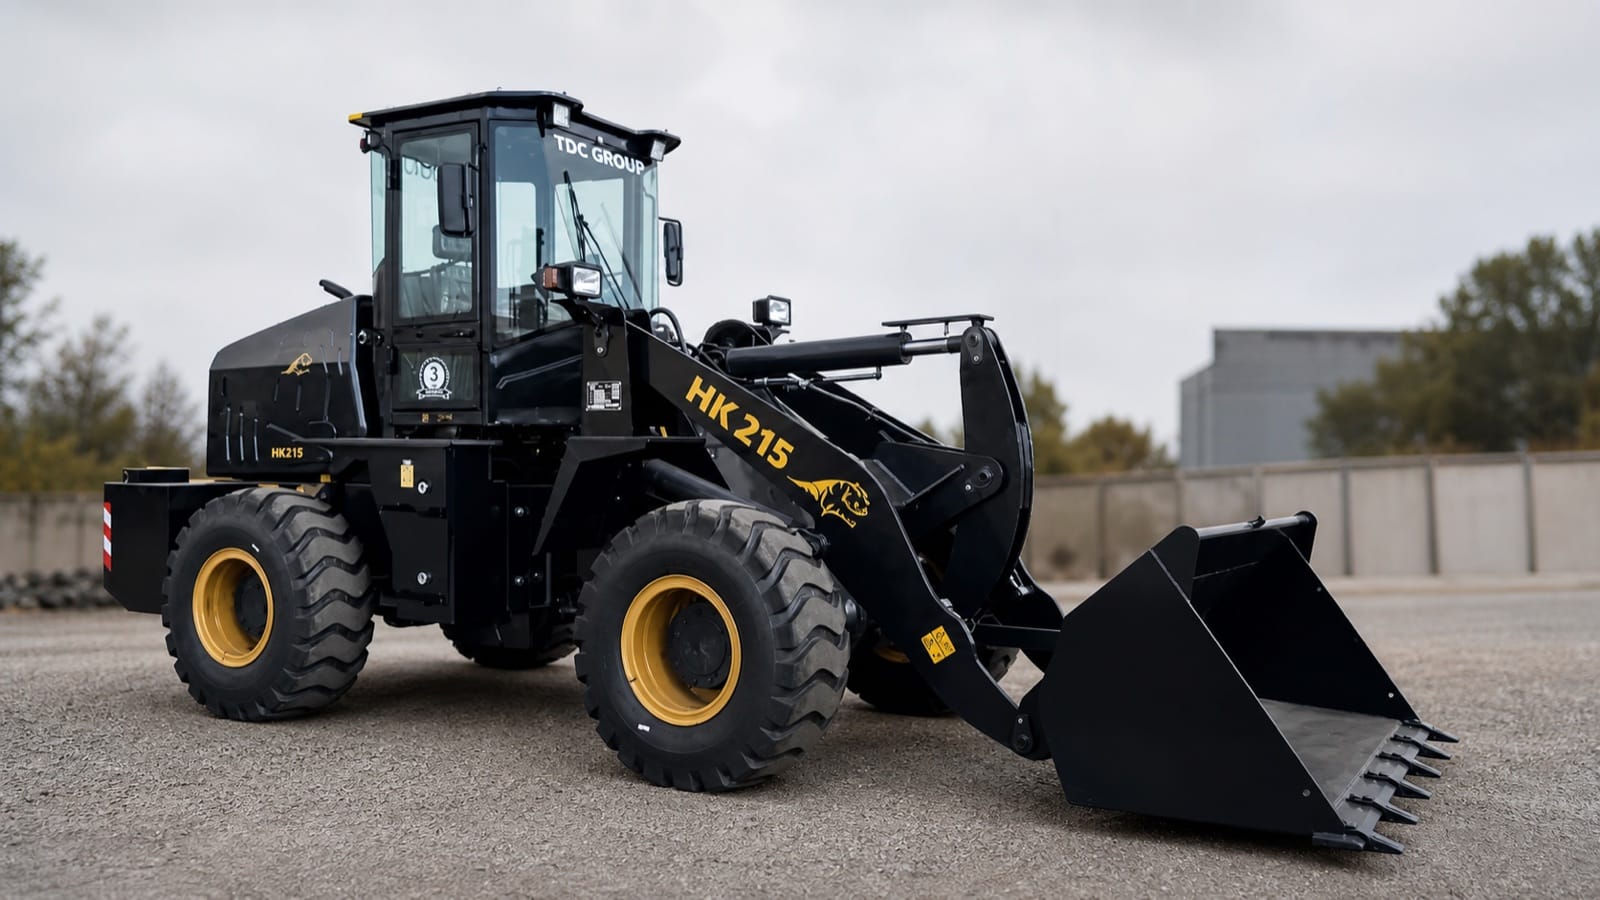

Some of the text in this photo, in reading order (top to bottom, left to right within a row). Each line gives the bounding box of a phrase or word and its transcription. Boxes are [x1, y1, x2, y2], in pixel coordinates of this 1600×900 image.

[553, 134, 645, 175] TDC GROUP
[430, 366, 438, 382] 3
[685, 375, 740, 431] HK
[733, 413, 794, 469] 215
[271, 447, 303, 458] HK215
